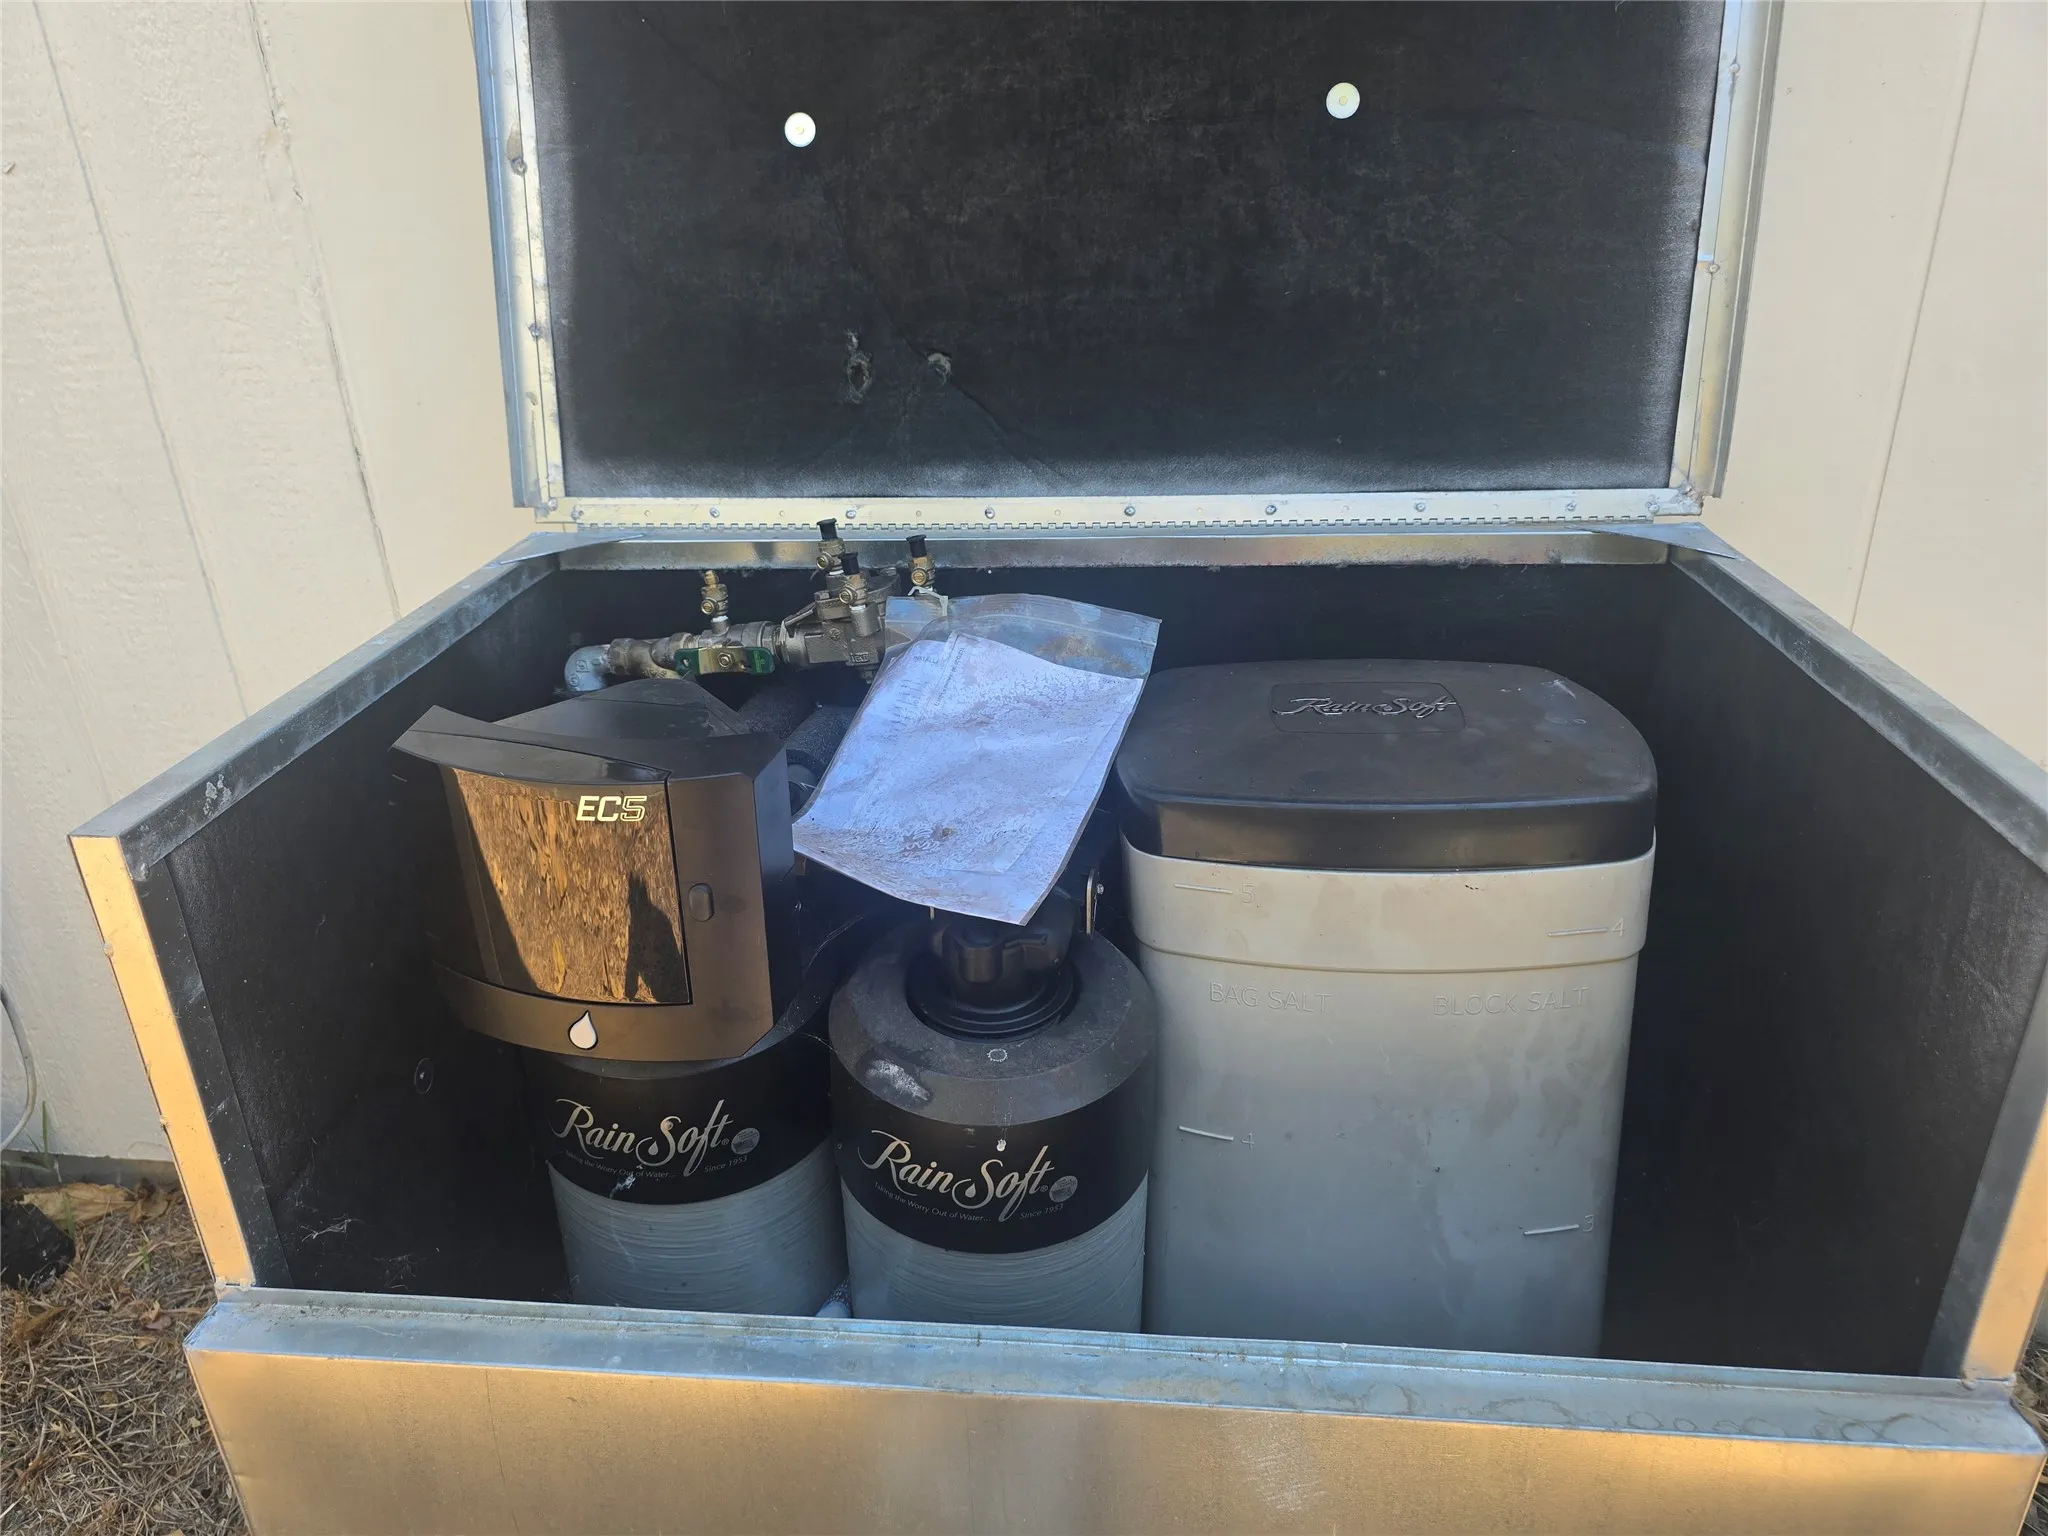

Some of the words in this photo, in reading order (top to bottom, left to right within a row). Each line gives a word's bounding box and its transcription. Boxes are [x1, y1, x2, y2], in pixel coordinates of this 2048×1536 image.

[576, 795, 648, 822] EC5
[1241, 882, 1256, 904] 5
[1611, 917, 1627, 937] 4
[1209, 981, 1260, 1008] BAG
[1267, 988, 1333, 1013] SALT
[1433, 992, 1520, 1017] BLOCK
[1526, 986, 1590, 1013] SALT
[1240, 1132, 1256, 1151] 4
[596, 1163, 618, 1175] Worry
[704, 1162, 726, 1173] Since
[728, 1154, 748, 1167] 1953
[874, 1181, 894, 1199] Taking
[907, 1199, 930, 1214] Worry
[931, 1207, 948, 1217] Out
[948, 1211, 958, 1219] of
[1020, 1210, 1042, 1220] Since
[1583, 1214, 1595, 1232] 3
